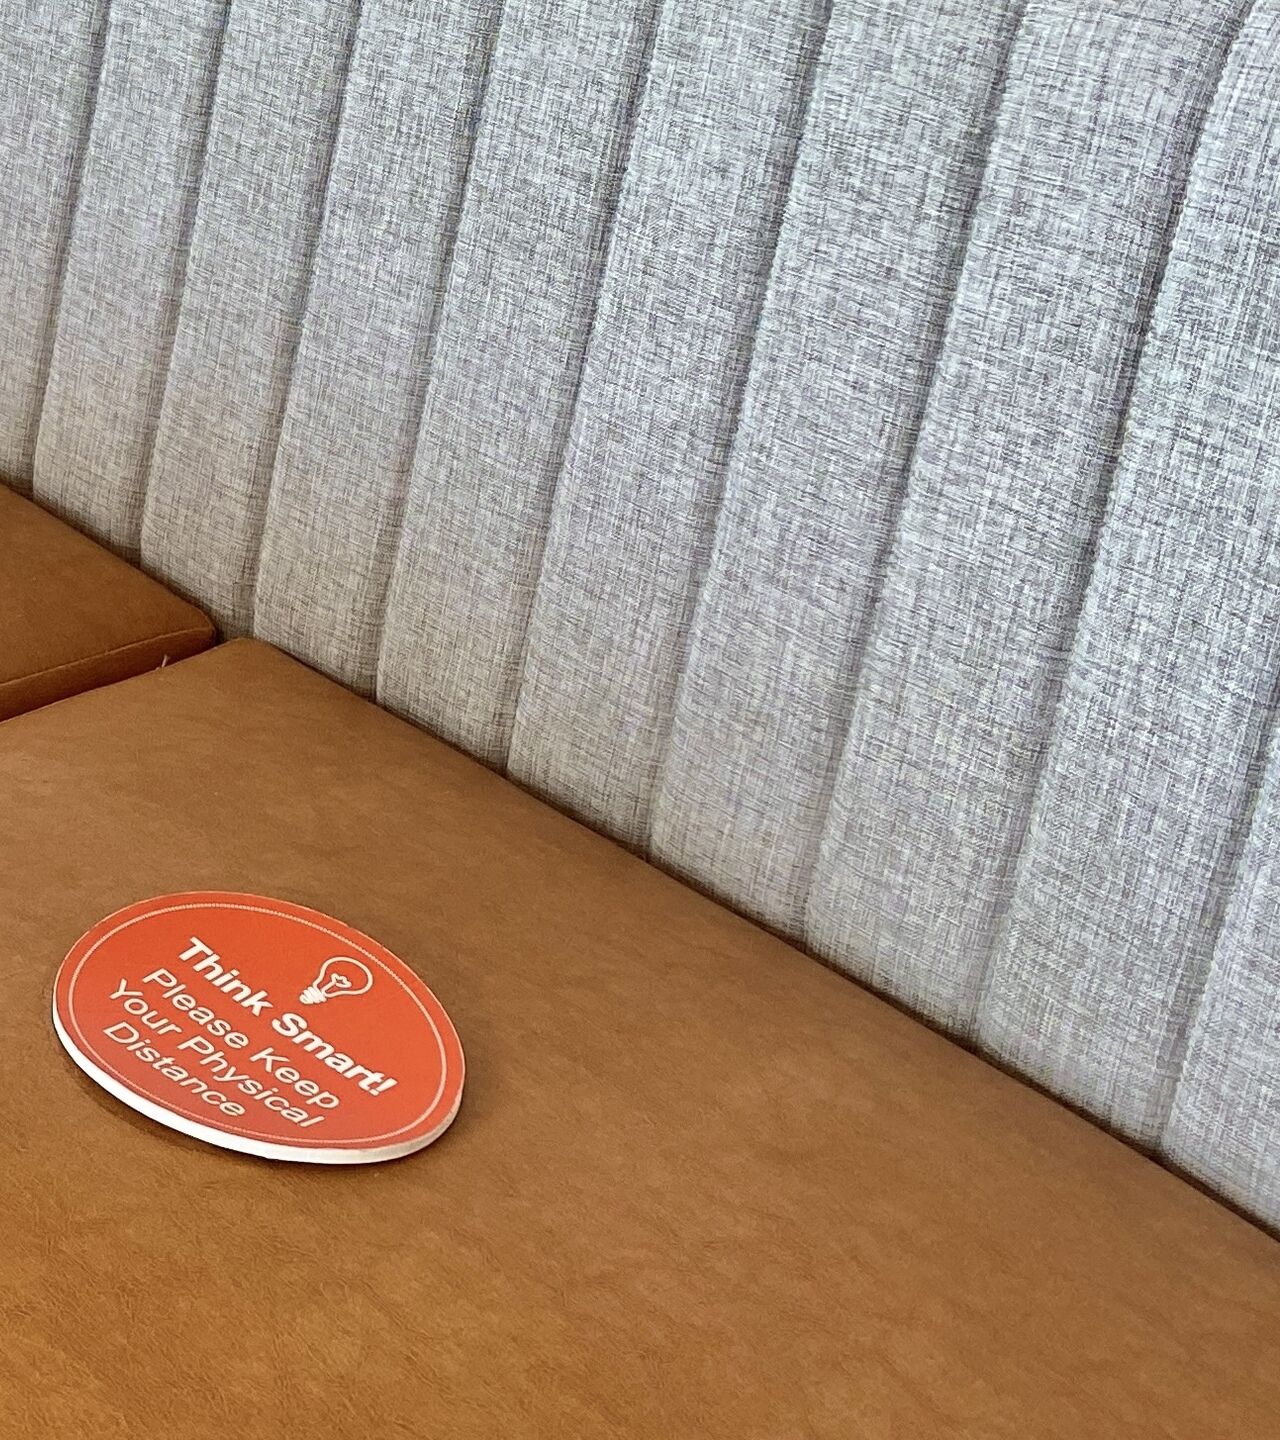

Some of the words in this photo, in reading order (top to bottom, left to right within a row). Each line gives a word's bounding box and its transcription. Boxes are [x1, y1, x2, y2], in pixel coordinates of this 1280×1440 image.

[103, 1021, 246, 1117] Distance
[108, 978, 183, 1036] Your
[177, 1036, 326, 1128] Physical
[143, 967, 249, 1050] Please
[249, 1047, 341, 1110] Keep
[178, 936, 274, 1017] Think
[271, 1012, 398, 1097] Smart!
